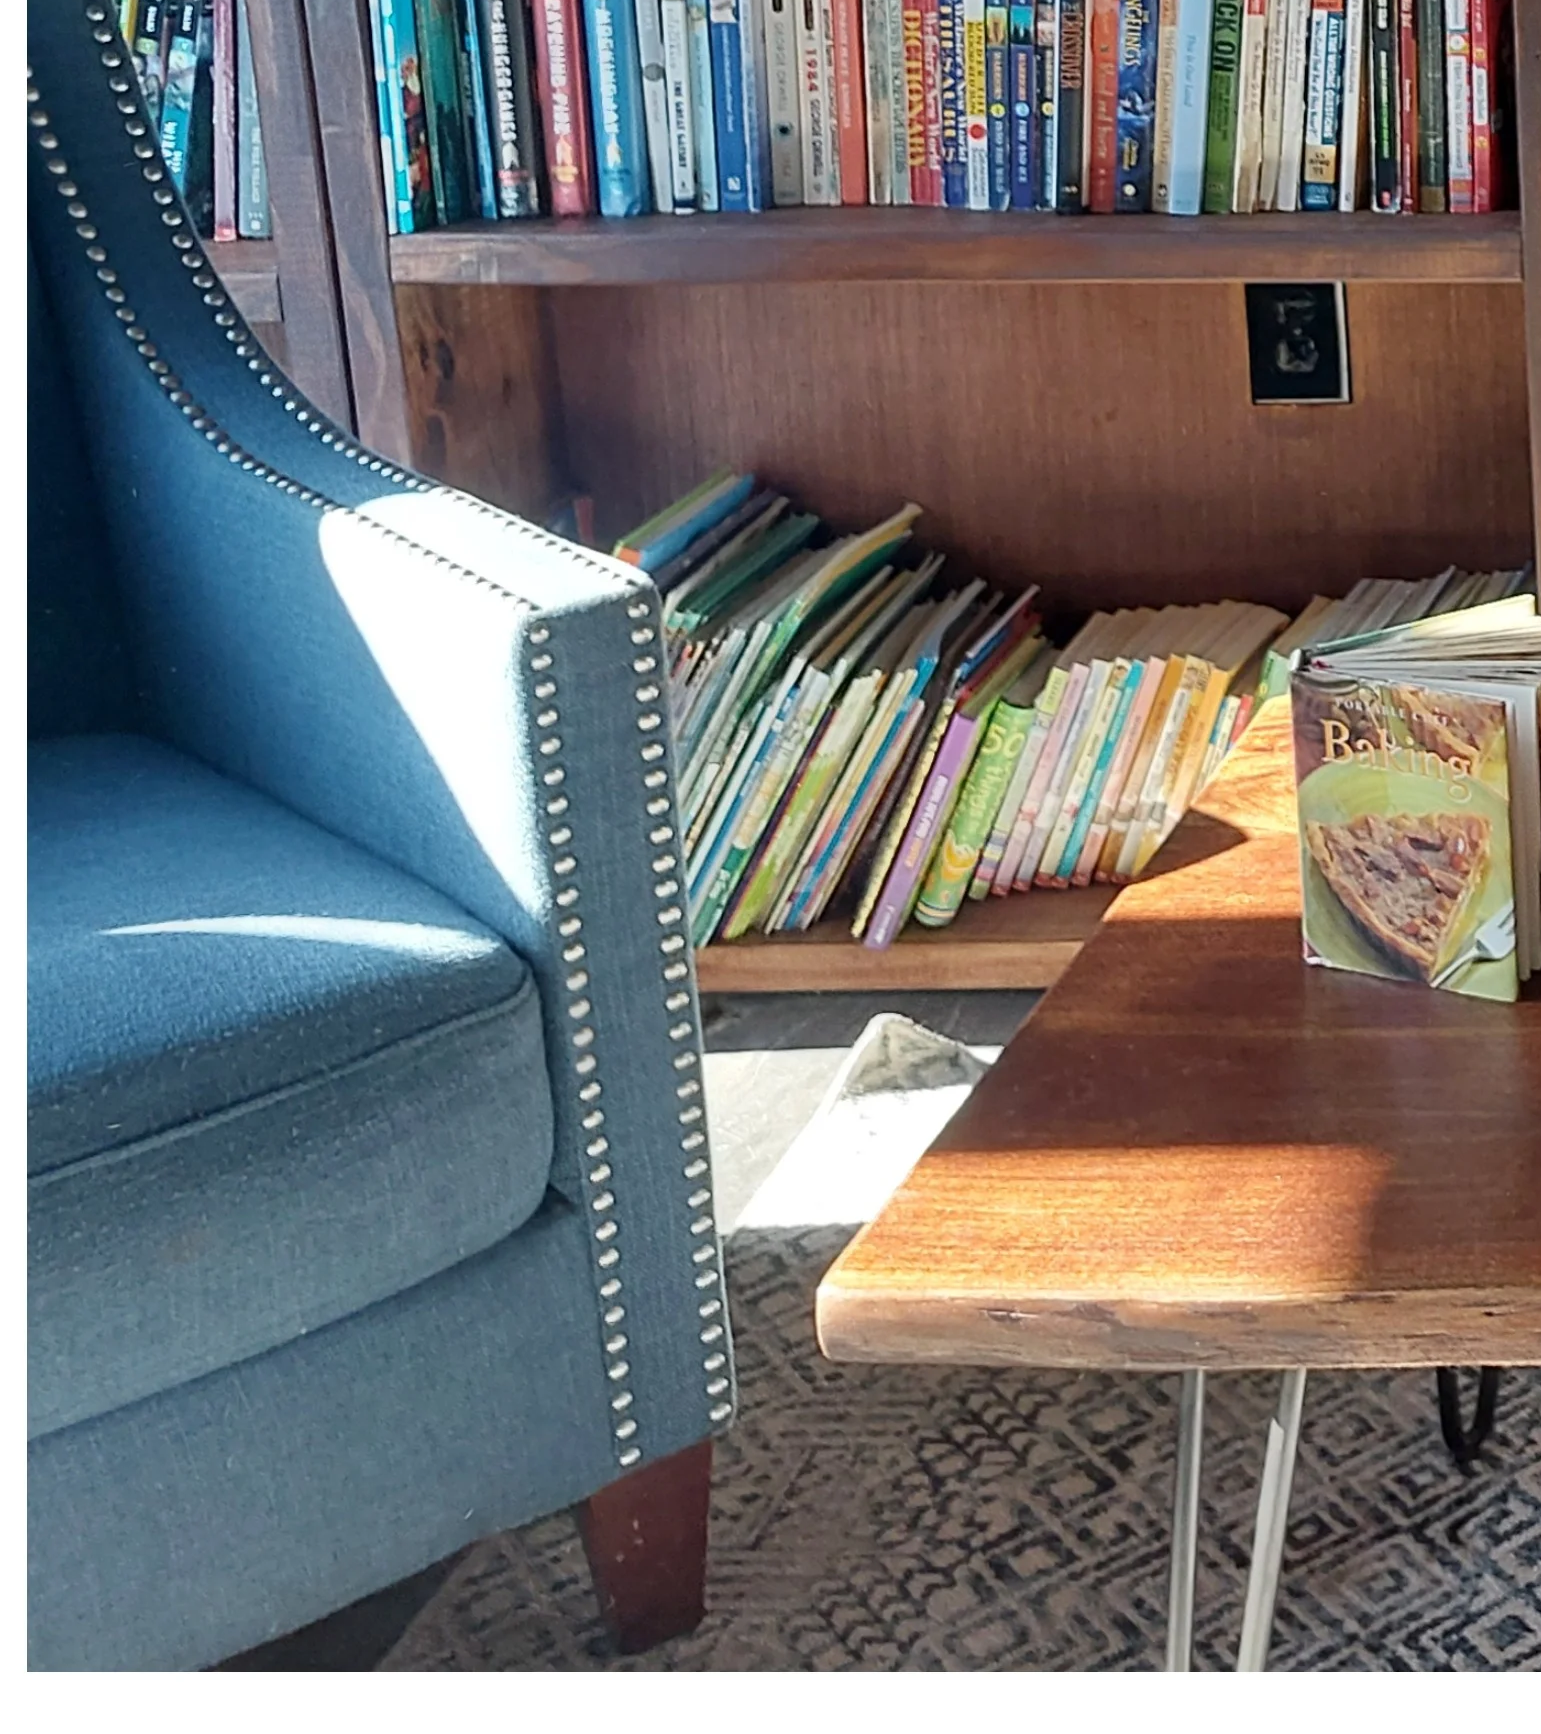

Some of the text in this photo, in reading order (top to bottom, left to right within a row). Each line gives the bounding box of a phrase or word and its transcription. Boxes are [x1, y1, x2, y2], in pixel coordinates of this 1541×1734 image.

[904, 10, 925, 166] DICTIONARY
[1061, 12, 1082, 90] CROSSOVER
[1214, 40, 1234, 73] ON
[1320, 719, 1472, 803] Baking
